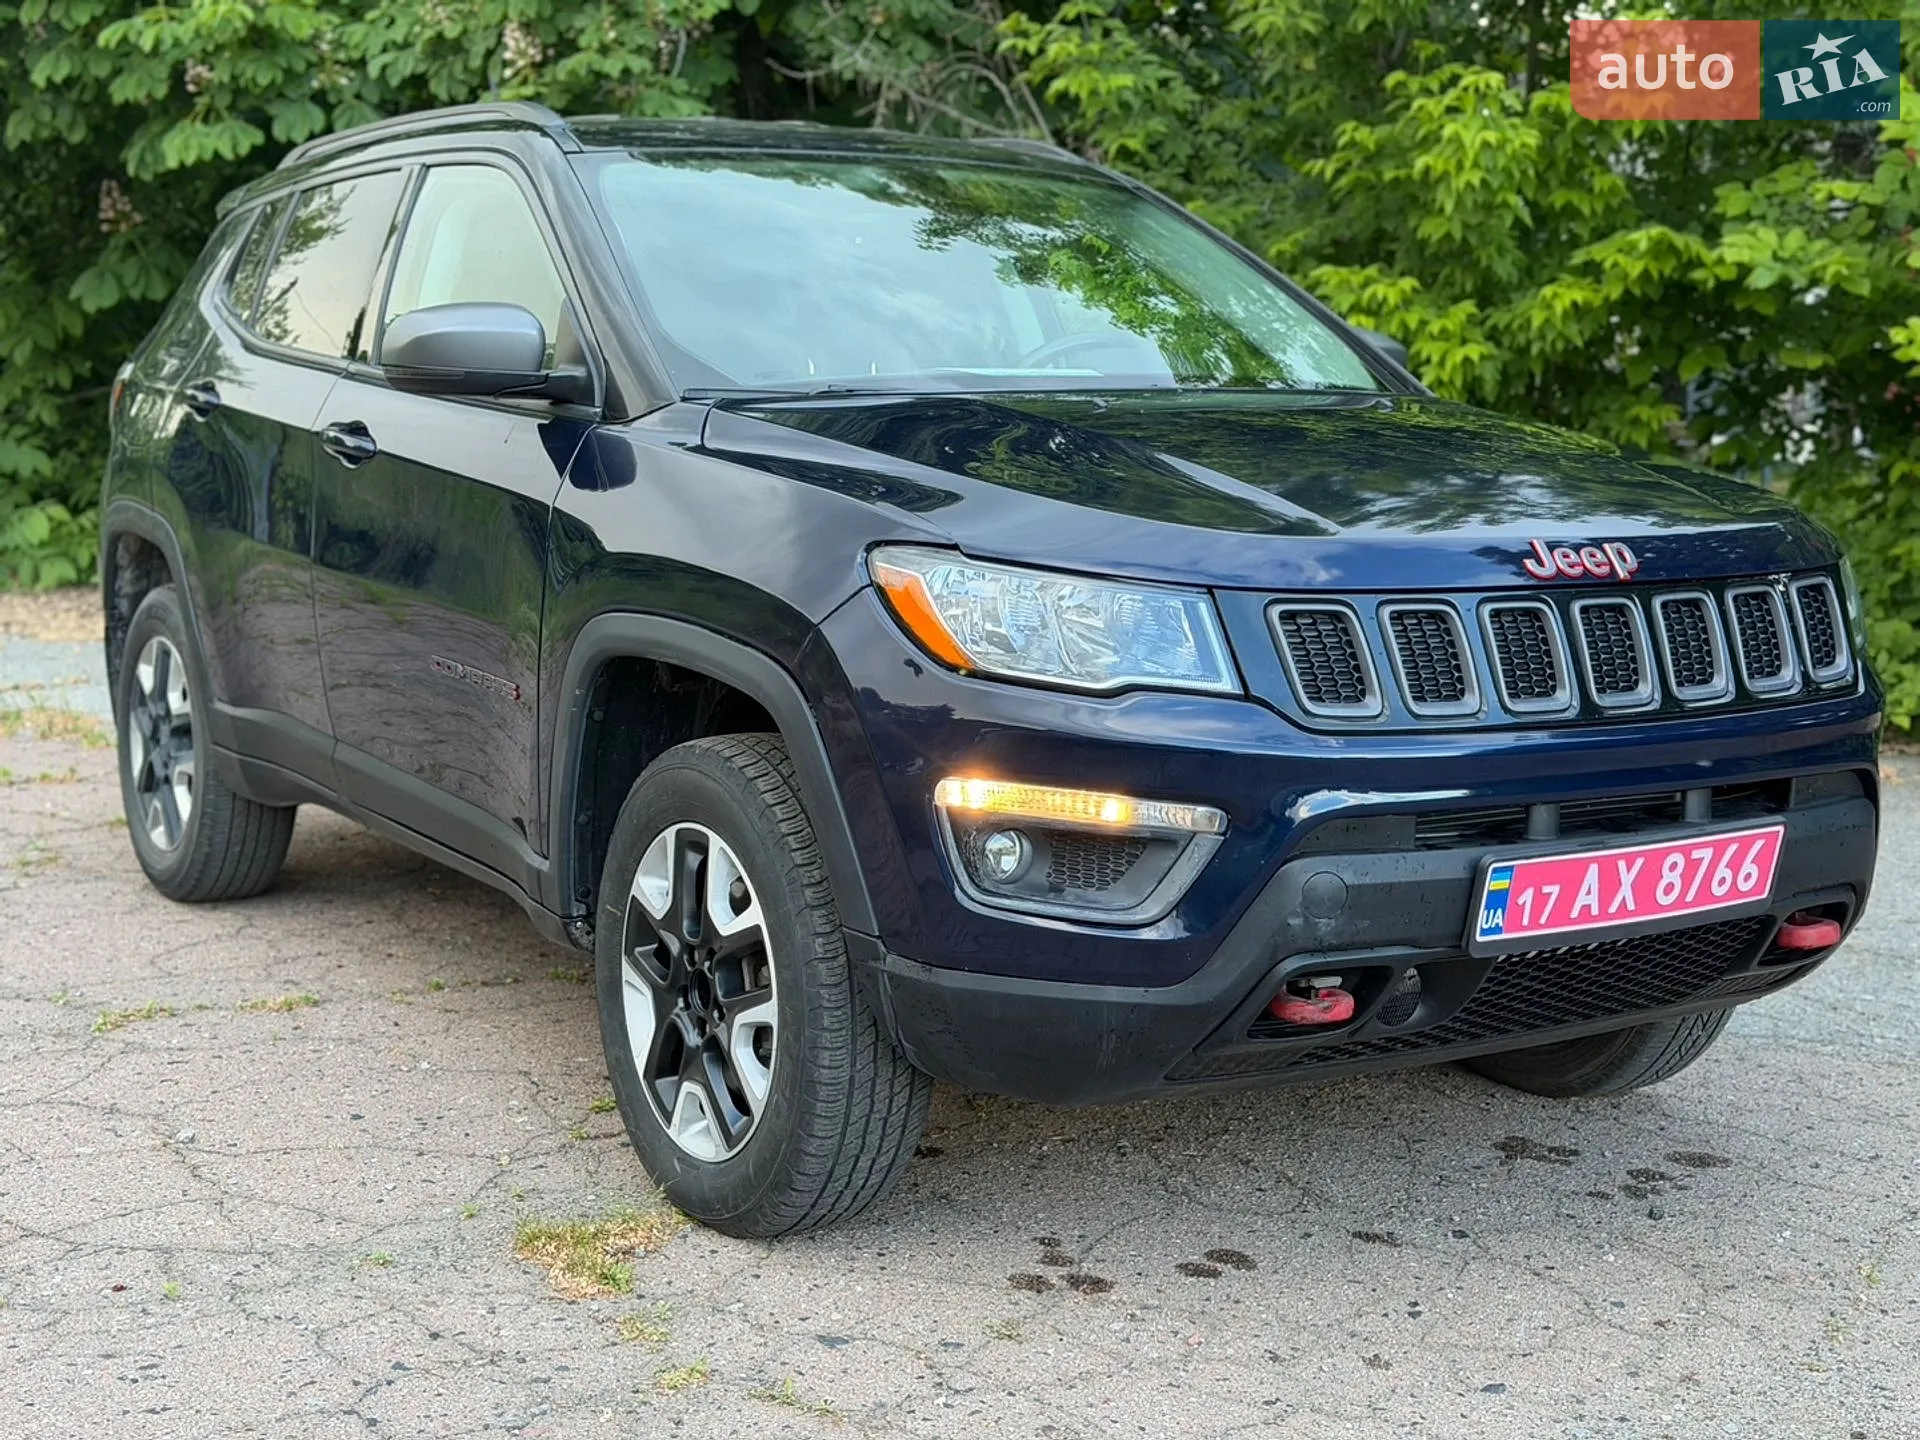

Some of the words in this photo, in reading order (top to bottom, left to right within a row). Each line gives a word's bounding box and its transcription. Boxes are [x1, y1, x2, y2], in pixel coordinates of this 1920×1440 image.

[1522, 537, 1640, 582] Jeep
[1516, 884, 1561, 927] 17
[1569, 856, 1646, 919] AX
[1654, 838, 1767, 906] 8766
[1481, 908, 1504, 929] UA
